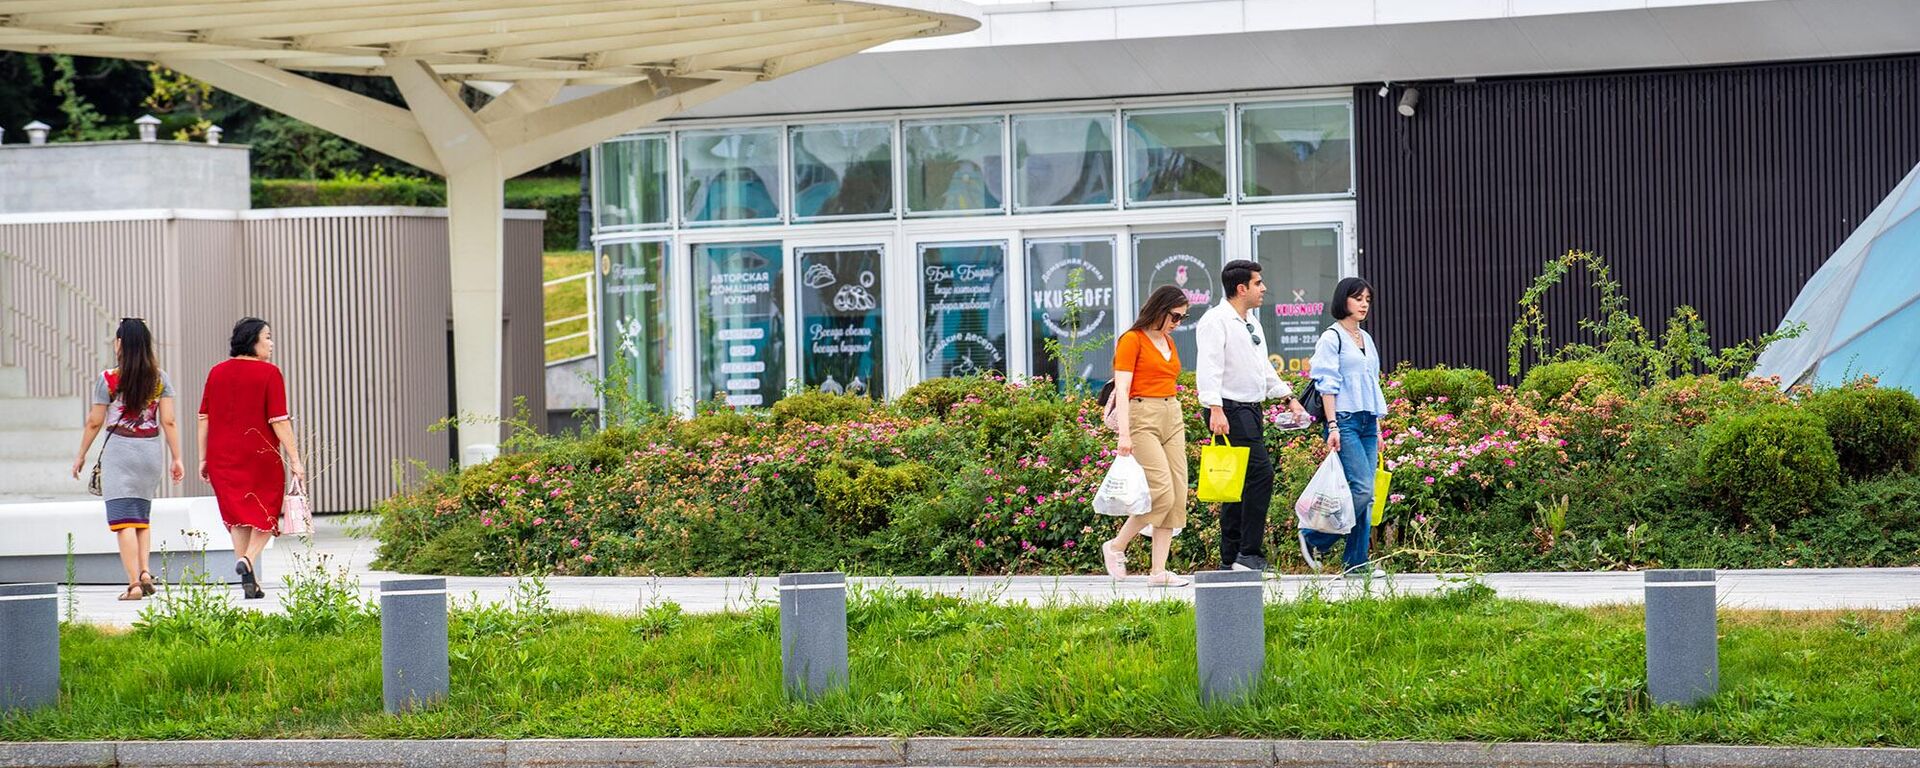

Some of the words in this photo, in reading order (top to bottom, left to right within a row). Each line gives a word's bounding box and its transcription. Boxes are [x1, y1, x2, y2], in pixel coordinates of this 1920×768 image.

[711, 271, 769, 284] АВТОРСКАЯ
[710, 282, 770, 296] ДОМАШНЯЯ
[934, 283, 953, 299] вкус
[953, 283, 991, 297] который
[723, 294, 757, 305] КУХНЯ
[1275, 302, 1324, 316] VKUSNOFF
[810, 323, 844, 341] Всегда
[813, 341, 839, 357] всегда
